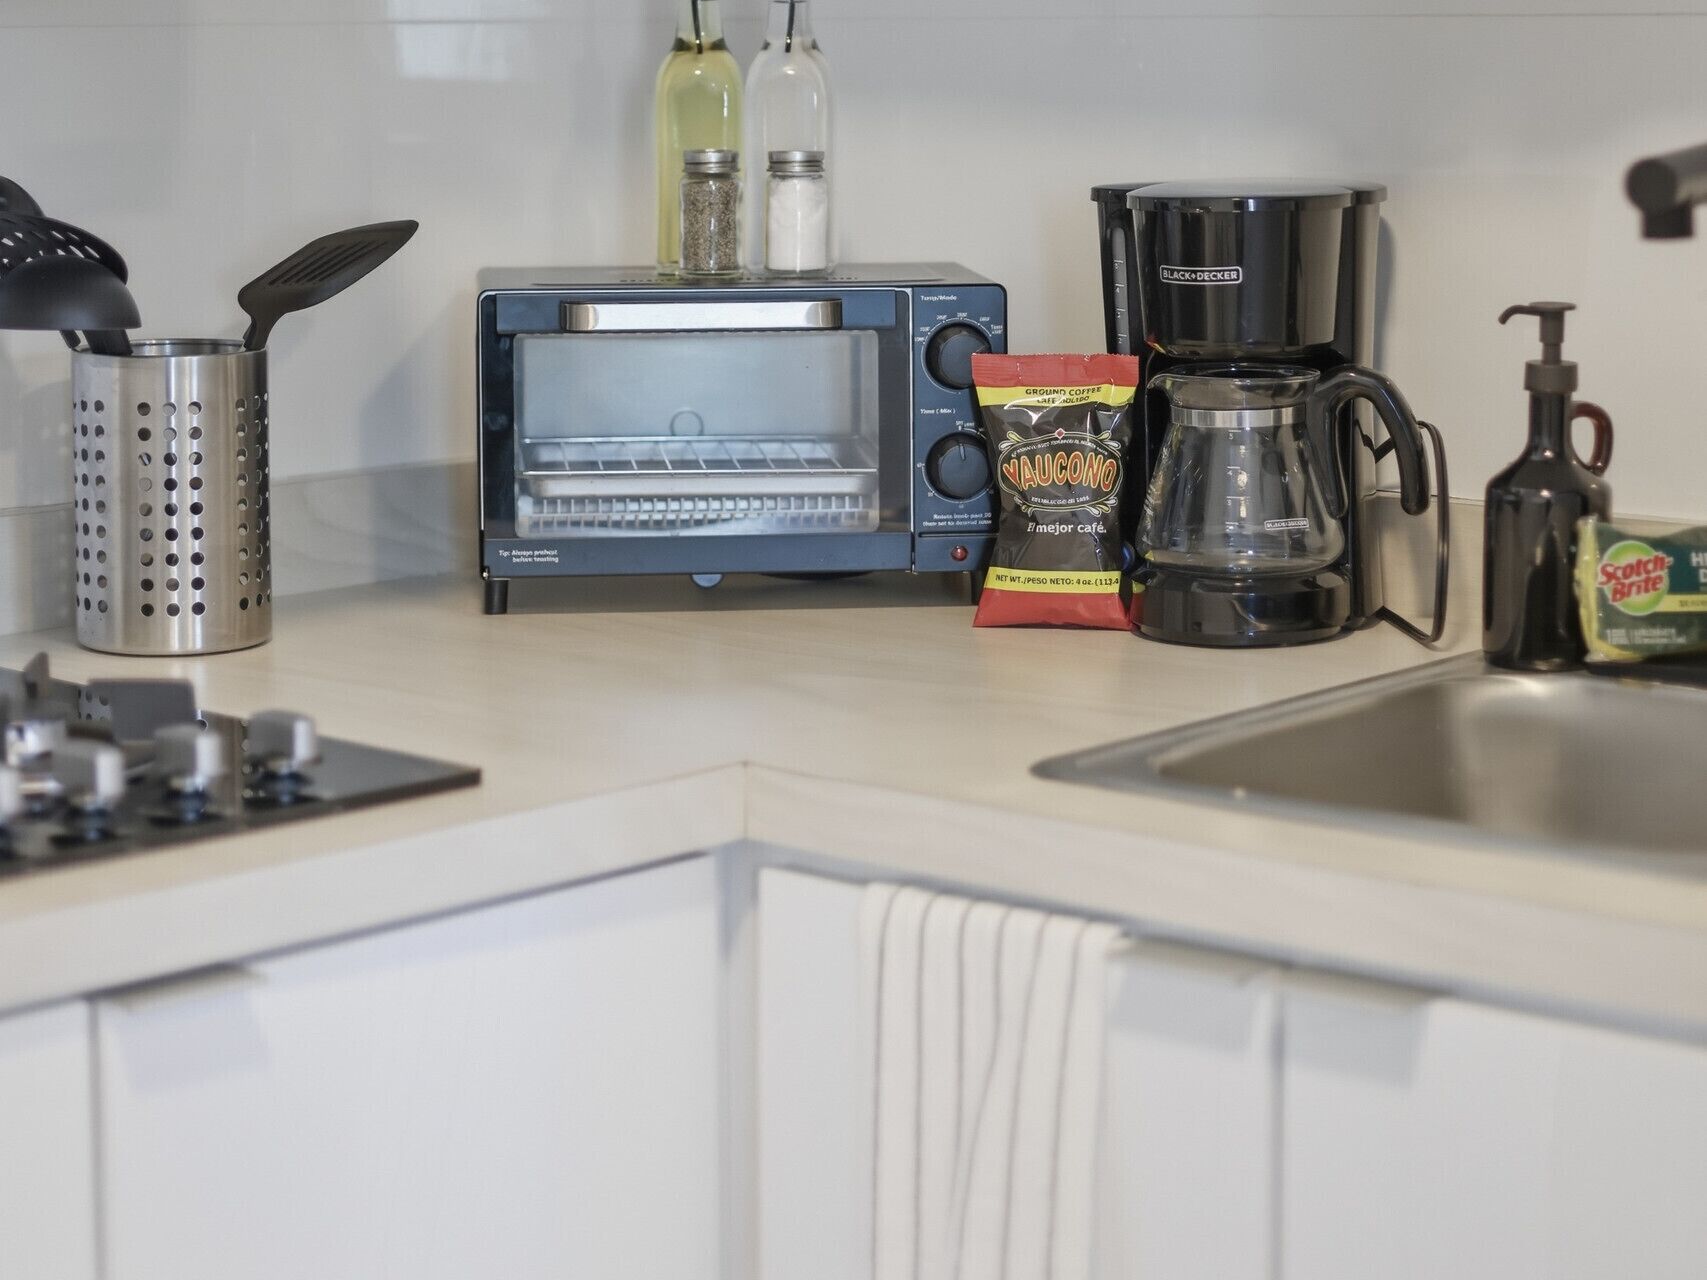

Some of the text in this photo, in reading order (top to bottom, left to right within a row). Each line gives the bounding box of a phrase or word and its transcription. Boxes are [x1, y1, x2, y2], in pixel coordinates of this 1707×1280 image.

[1162, 269, 1238, 281] BLACK+DECKER
[1025, 386, 1102, 396] GROUND COFFEE
[1002, 451, 1117, 492] YAUCONO
[1036, 522, 1074, 535] mejor
[995, 574, 1008, 582] NET
[1610, 574, 1665, 604] Brite
